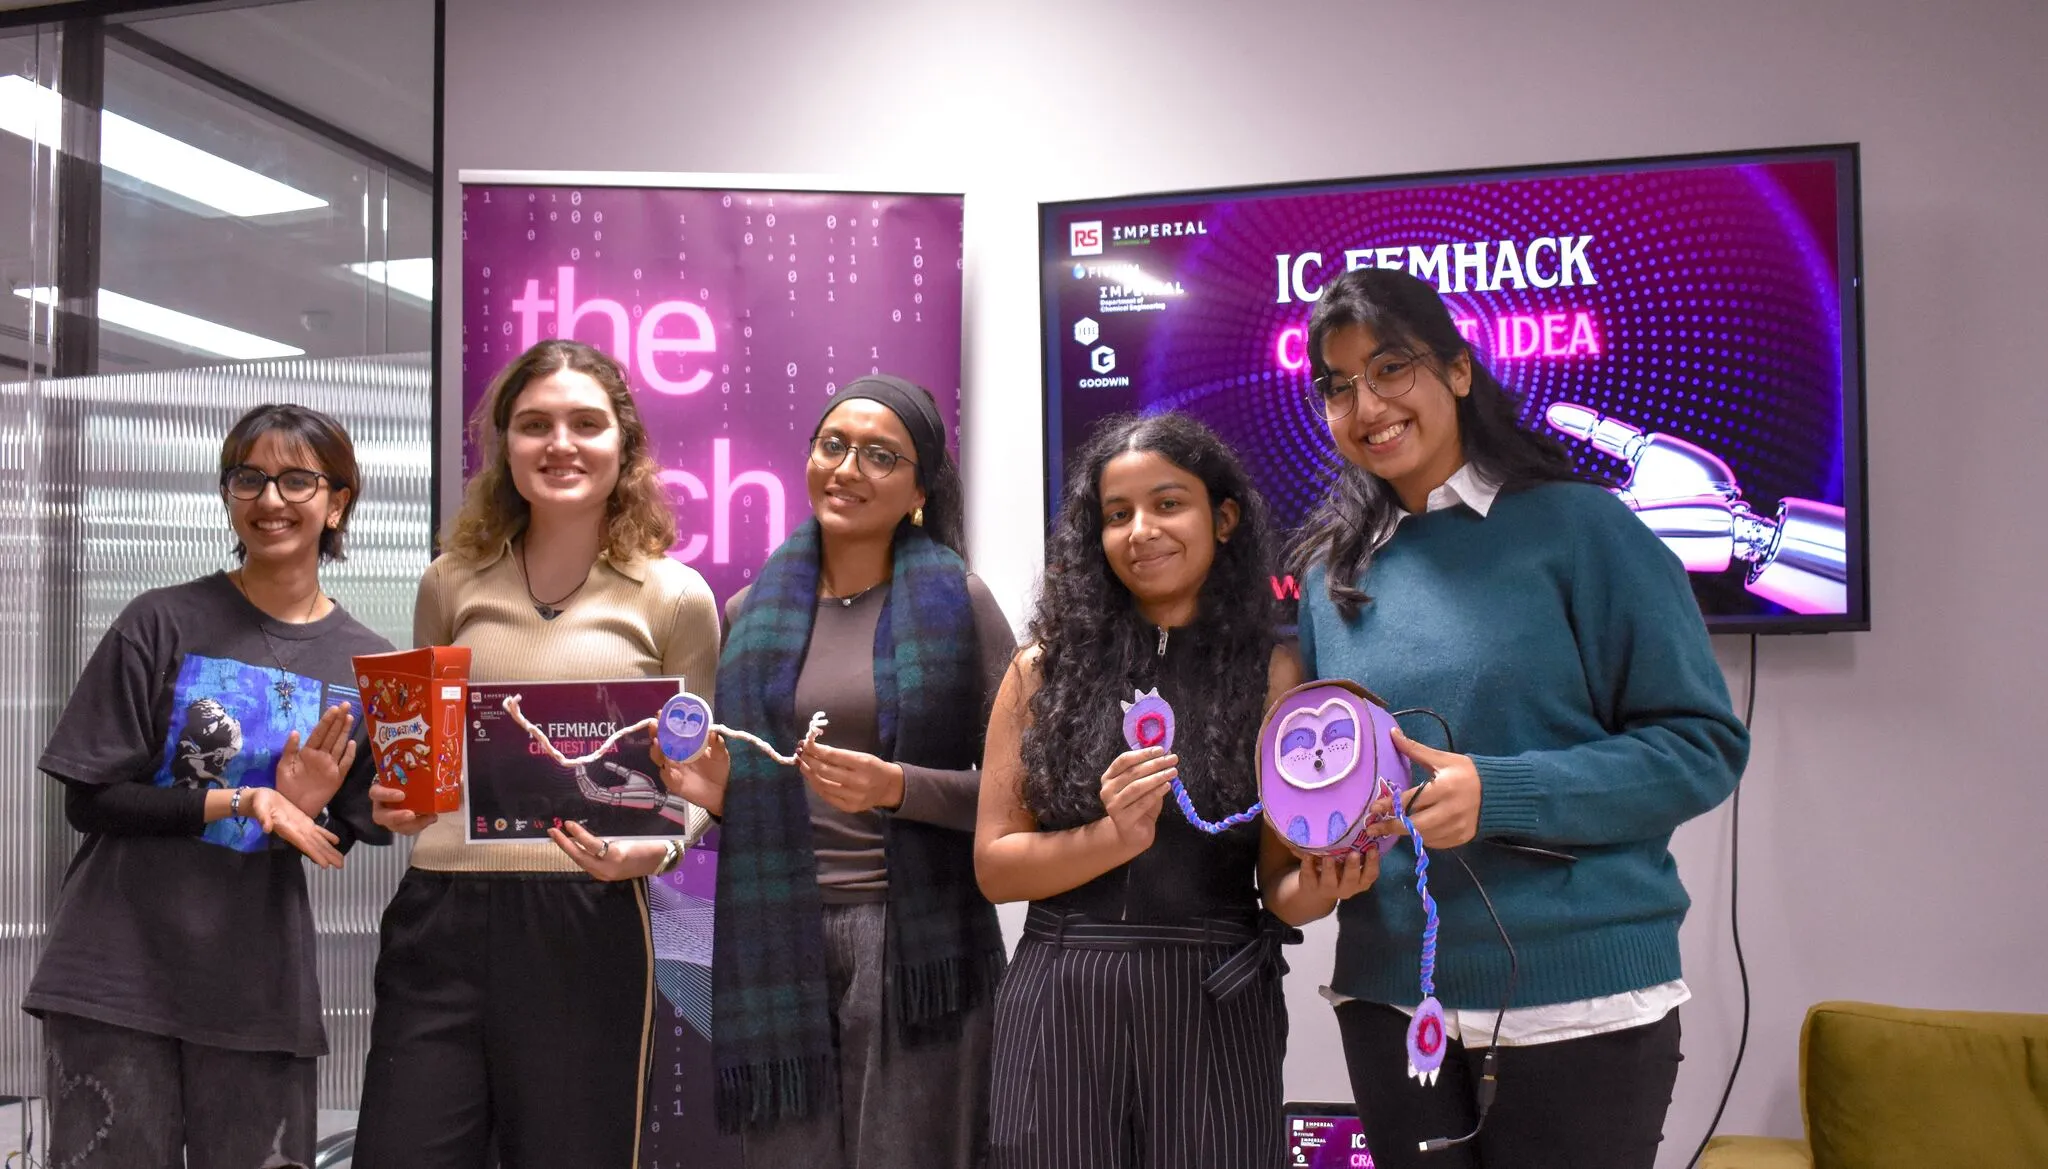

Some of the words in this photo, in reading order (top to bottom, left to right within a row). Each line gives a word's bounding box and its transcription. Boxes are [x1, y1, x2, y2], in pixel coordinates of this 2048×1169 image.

[1075, 229, 1098, 247] RS
[1113, 221, 1207, 240] IMPERIAL
[1276, 252, 1322, 303] IC
[512, 266, 716, 396] the
[1497, 312, 1601, 358] IDEA
[1079, 376, 1129, 388] GOODWIN
[656, 438, 786, 565] ch
[548, 722, 616, 738] FEMHACK
[1351, 1133, 1366, 1149] IC
